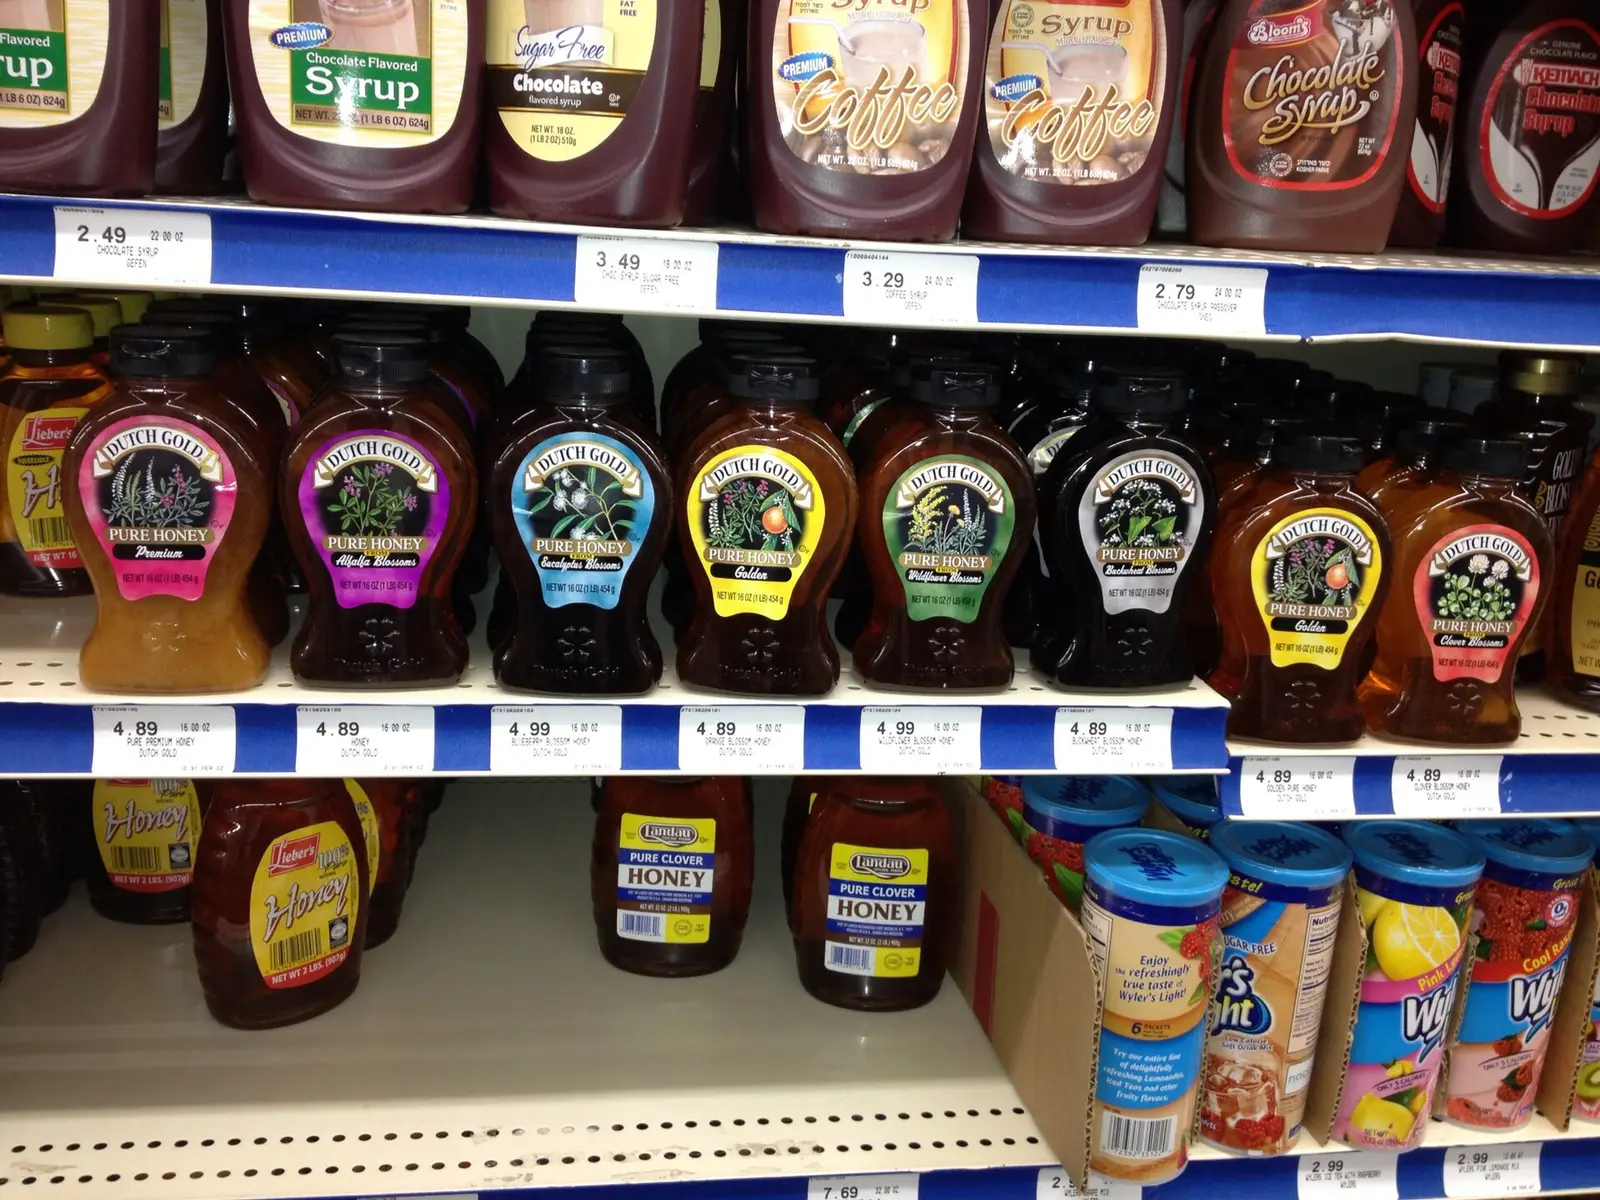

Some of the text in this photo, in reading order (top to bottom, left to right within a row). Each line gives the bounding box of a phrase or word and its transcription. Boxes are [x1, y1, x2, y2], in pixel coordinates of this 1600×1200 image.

[620, 0, 634, 8] FAT
[620, 9, 637, 17] FREE
[1041, 14, 1133, 38] Syrup
[1248, 15, 1311, 45] Bloom's
[276, 28, 328, 44] PREMIUM
[514, 25, 605, 71] Sugar Free
[306, 52, 418, 73] Chocolate Flavored
[783, 56, 828, 76] PREMIUM
[1243, 38, 1386, 110] Chocolate
[305, 66, 419, 109] Syrup
[512, 74, 603, 95] Chocolate
[995, 78, 1037, 98] PREMIUM
[44, 96, 66, 109] 624g
[529, 95, 581, 109] flavored syrup
[793, 64, 958, 150] Coffee
[296, 109, 331, 121] NET WT.
[1002, 83, 1155, 161] Coffee
[1259, 86, 1371, 145] Syrup
[371, 115, 429, 131] LB OZ) 624g
[531, 124, 564, 135] NET 18
[562, 137, 577, 148] 510g
[77, 224, 184, 244] 2.49 22 00 OZ
[97, 244, 159, 257] CHOCOLATE SYRUP
[126, 258, 147, 269] GEFEN
[596, 251, 640, 270] 3.49
[862, 271, 904, 288] 3.29
[886, 289, 928, 301] COFFEE SYRUP
[1155, 283, 1196, 300] 2.79
[21, 415, 73, 449] Lieber's
[106, 429, 204, 458] DUTCH GOLD
[326, 441, 421, 470] DUTCH GOLD
[537, 446, 626, 474] DUTCH GOLD
[713, 457, 799, 486] DUTCH GOLD
[1108, 460, 1187, 487] DUTCH GOLD
[911, 465, 995, 494] DUTCH GOLD
[109, 528, 209, 542] PURE HONEY
[1282, 519, 1363, 546] DUTCH GOLD
[328, 537, 422, 550] PURE HONEY
[536, 540, 626, 554] PURE HONEY
[1445, 536, 1523, 562] DUTCH GOLD
[34, 551, 77, 562] NET WT 16
[135, 545, 184, 559] Premium
[708, 549, 796, 566] PURE HONEY
[1101, 548, 1181, 560] PURE HONEY
[336, 554, 416, 567] Alfalfa Blossoms
[541, 556, 621, 572] Eucalyptus Blossoms
[903, 554, 988, 569] PURE HONEY
[735, 566, 768, 580] Golden
[908, 569, 982, 584] Wildflower Blossoms
[1145, 565, 1176, 576] Blossoms
[1270, 603, 1353, 618] PURE HONEY
[1294, 619, 1327, 633] Golden
[1433, 619, 1513, 633] PURE HONEY
[1440, 635, 1504, 647] Clover Blossoms
[113, 721, 158, 736] 4.89
[316, 722, 360, 736] 4.89
[509, 722, 550, 736] 4.99
[696, 722, 736, 736] 4.89
[877, 721, 915, 735] 4.99
[1070, 722, 1107, 736] 4.89
[127, 737, 195, 747] PURE PREMIUM HONEY
[351, 737, 369, 747] HONEY
[139, 748, 177, 758] DUTCH GOLD
[1256, 769, 1292, 783] 4.89
[1406, 768, 1441, 782] 4.89
[104, 798, 189, 844] Honey
[267, 839, 316, 873] Lieber's
[630, 852, 704, 867] PURE CLOVER
[627, 867, 706, 888] HONEY
[840, 883, 916, 899] PURE CLOVER
[263, 873, 349, 944] Honey
[837, 899, 918, 922] HONEY
[1251, 940, 1276, 955] FREE
[1139, 955, 1170, 968] Enjoy
[1522, 954, 1551, 974] Cool
[272, 972, 288, 985] NET
[288, 969, 302, 980] WT
[301, 967, 308, 977] 2
[1129, 963, 1191, 981] refreshingly
[1123, 978, 1174, 991] true taste
[1418, 968, 1446, 992] Pink
[1119, 988, 1187, 1005] Wyler's Light!
[1131, 1021, 1142, 1036] 6
[1312, 1159, 1344, 1172] 2.99
[1457, 1153, 1488, 1165] 2.99
[823, 1187, 858, 1200] 7.69
